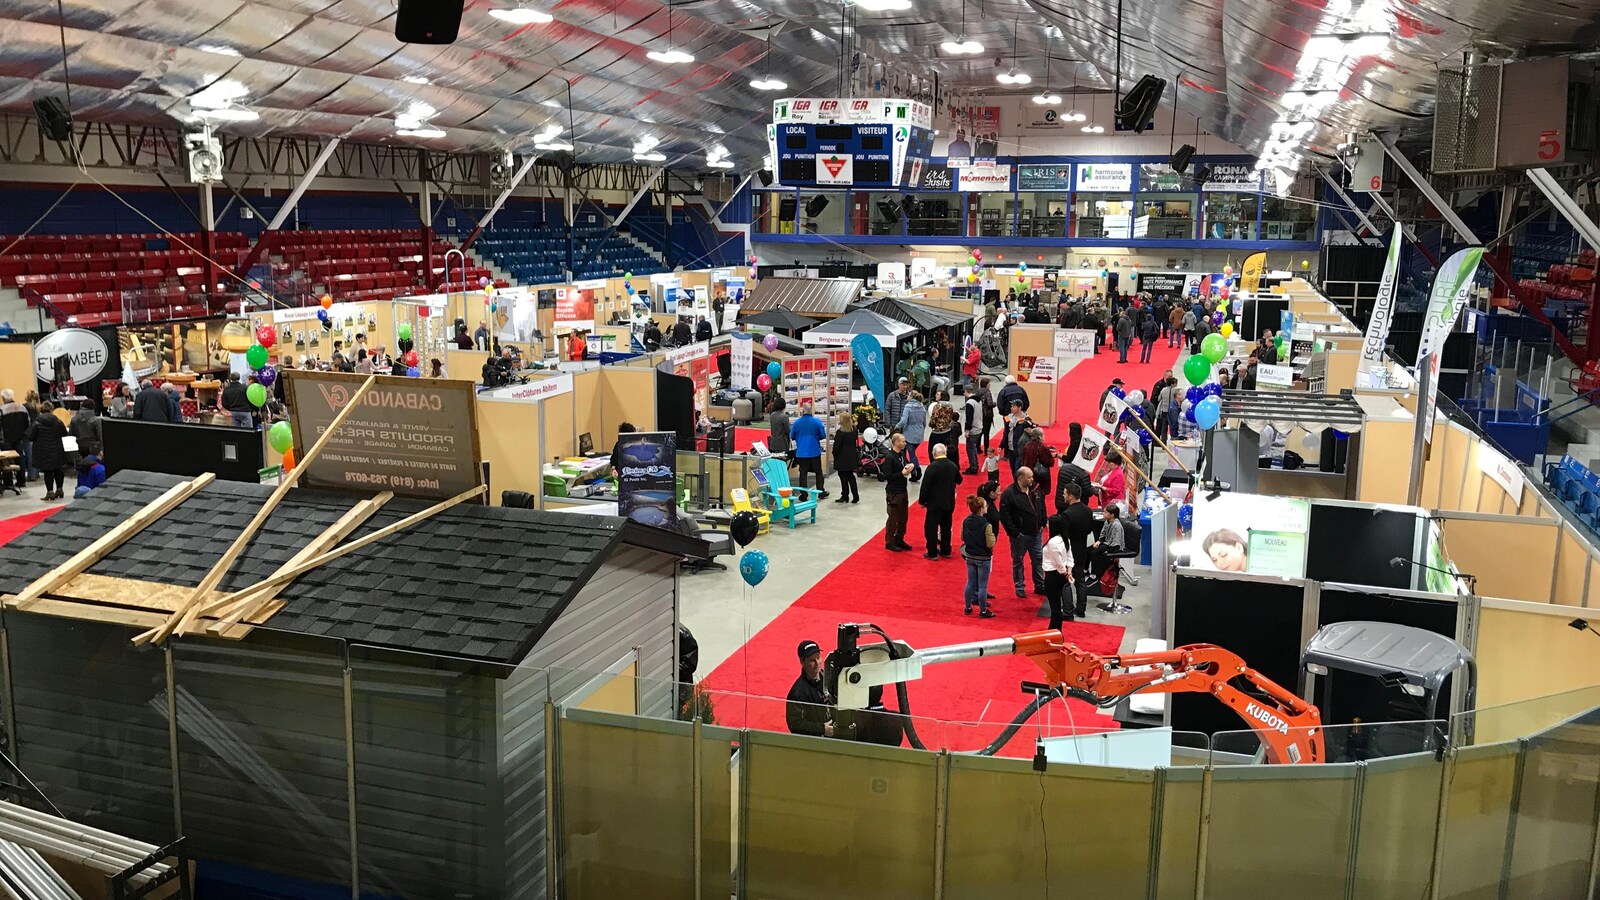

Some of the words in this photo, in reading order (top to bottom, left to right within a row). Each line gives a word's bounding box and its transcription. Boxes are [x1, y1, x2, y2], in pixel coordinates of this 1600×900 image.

[792, 101, 811, 110] IGA
[819, 101, 838, 110] IGA
[1538, 130, 1561, 160] 5
[1214, 166, 1248, 174] RONA
[1370, 176, 1380, 190] 6
[38, 347, 102, 371] FLMBÉE
[1265, 538, 1287, 547] NOUVEAU
[1245, 702, 1289, 735] KUBOTA
